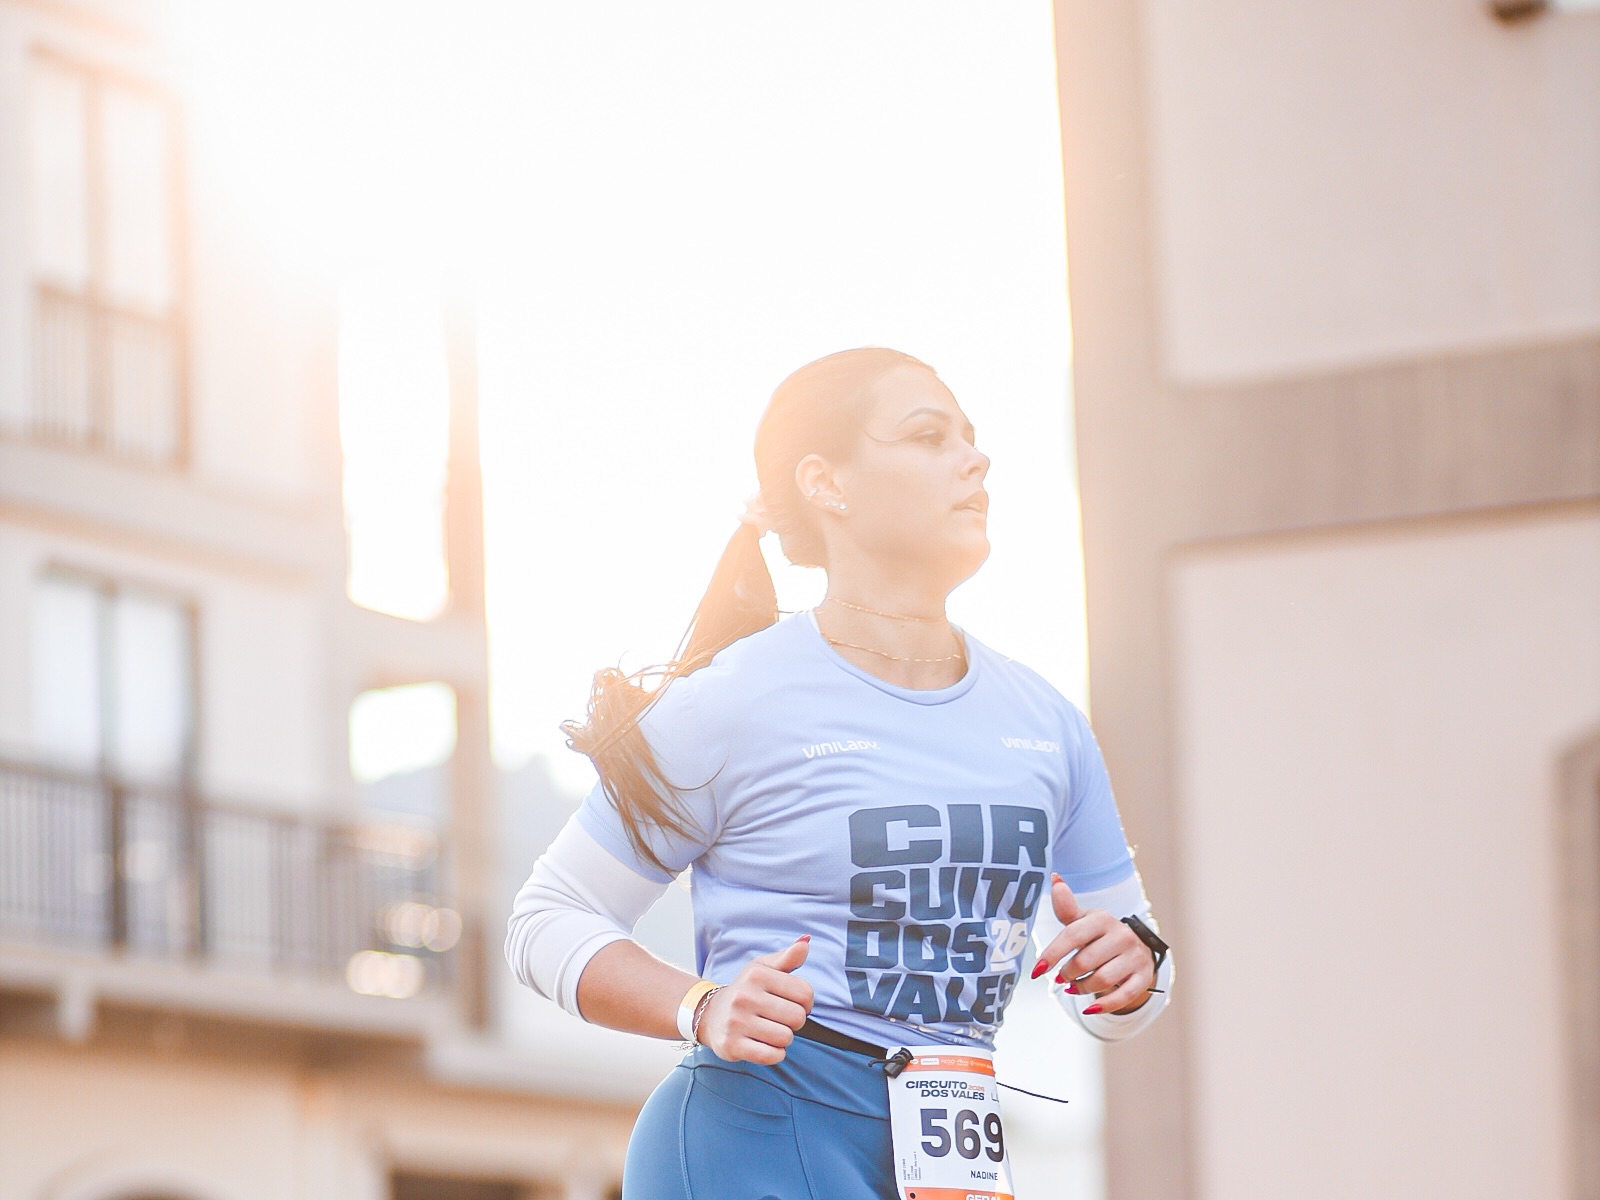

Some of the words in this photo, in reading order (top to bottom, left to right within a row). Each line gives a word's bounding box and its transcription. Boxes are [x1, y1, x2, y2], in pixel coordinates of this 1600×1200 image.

[848, 803, 1049, 868] CIR
[849, 866, 1045, 922] CUITO
[845, 920, 986, 974] DOS
[988, 919, 1028, 962] 26
[845, 971, 1017, 1024] VALES
[905, 1080, 968, 1090] CIRCUITO
[920, 1089, 949, 1098] DOS
[951, 1089, 985, 1101] VALES
[920, 1108, 1009, 1164] 569
[970, 1169, 999, 1181] NADINE
